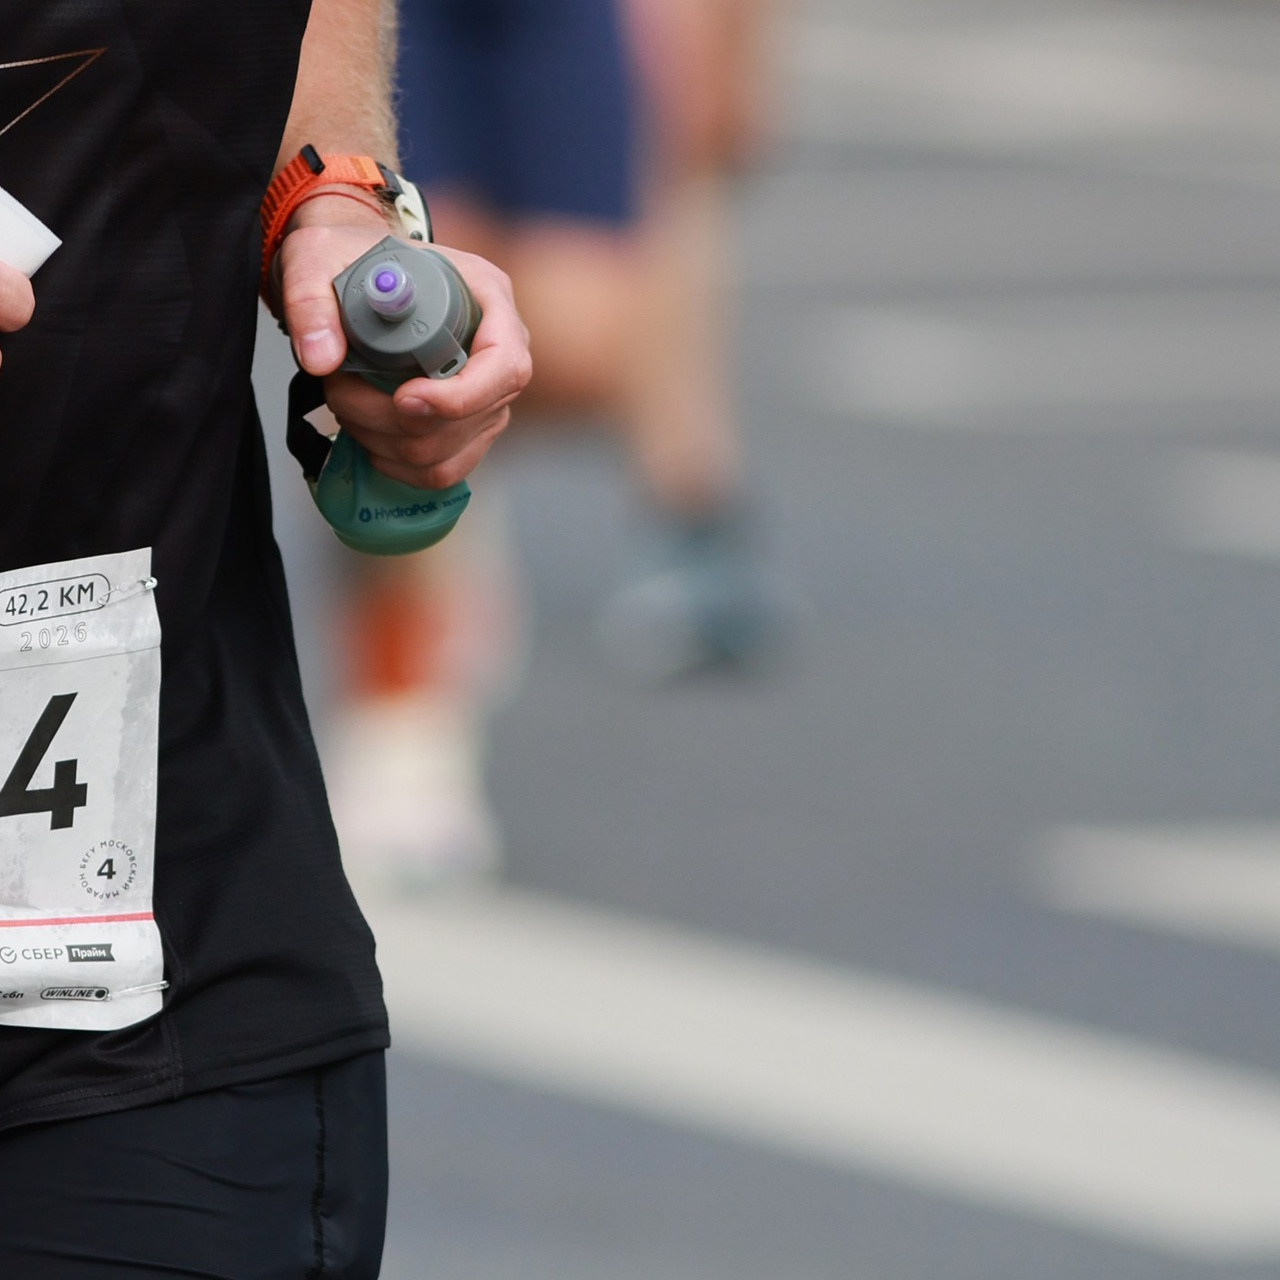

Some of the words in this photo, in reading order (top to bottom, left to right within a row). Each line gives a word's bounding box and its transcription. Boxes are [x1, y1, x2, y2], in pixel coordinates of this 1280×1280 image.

[375, 501, 438, 520] HydraPak
[5, 590, 49, 616] 42,2
[20, 622, 88, 652] 2026
[80, 846, 96, 869] БЕГУ
[96, 858, 117, 880] 4
[100, 839, 137, 891] МОСКОВСКИЙ
[79, 873, 119, 899] МАРАФОН
[22, 947, 63, 960] СБЕР
[71, 946, 107, 960] Прайм
[45, 989, 94, 998] WINLINE
